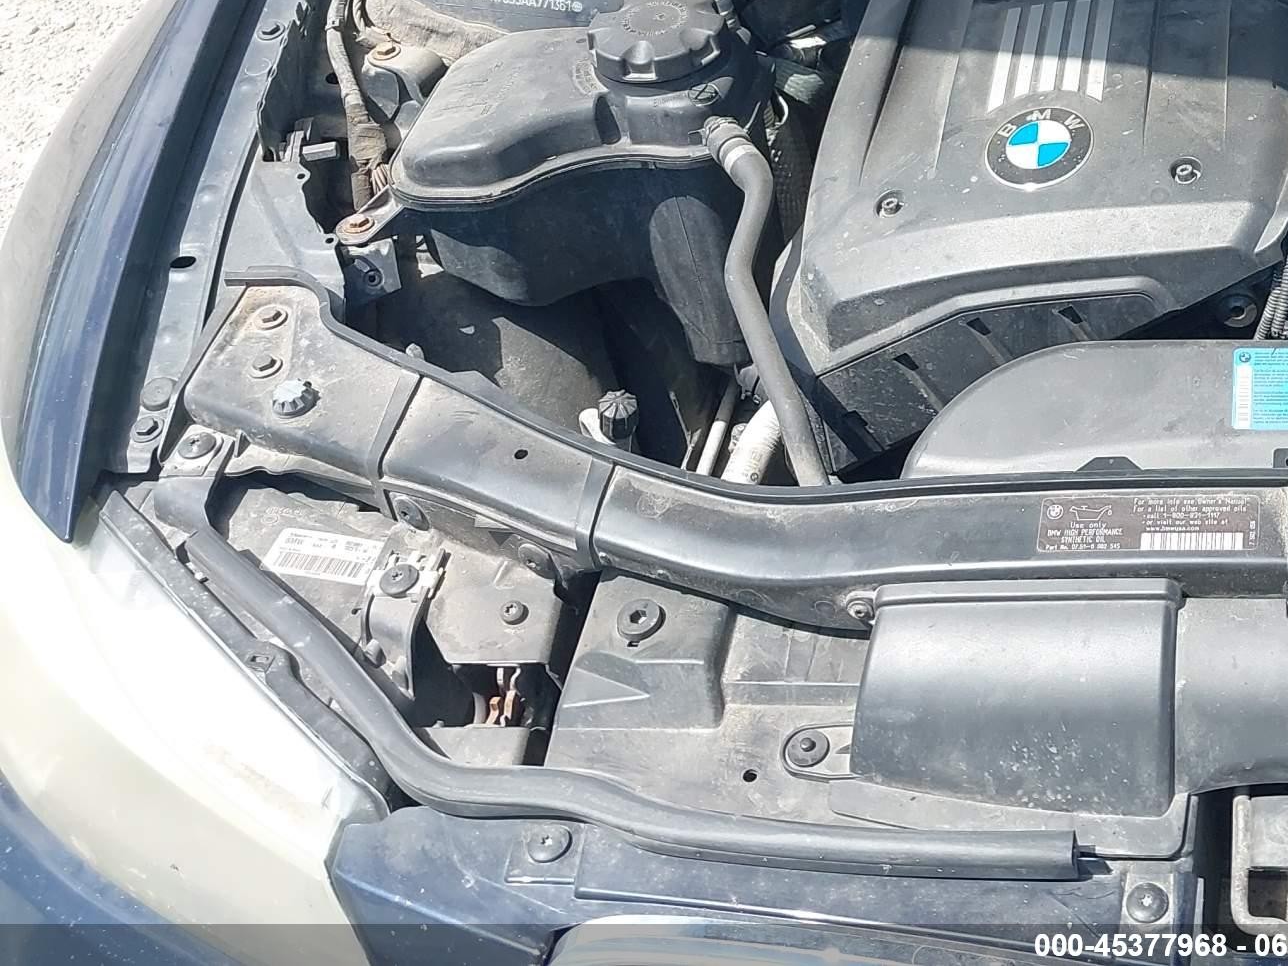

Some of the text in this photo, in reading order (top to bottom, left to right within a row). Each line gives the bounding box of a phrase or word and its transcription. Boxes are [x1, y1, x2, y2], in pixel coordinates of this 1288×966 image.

[997, 108, 1086, 138] BMW
[1089, 521, 1107, 529] only
[1081, 528, 1123, 536] PERFORMANCE
